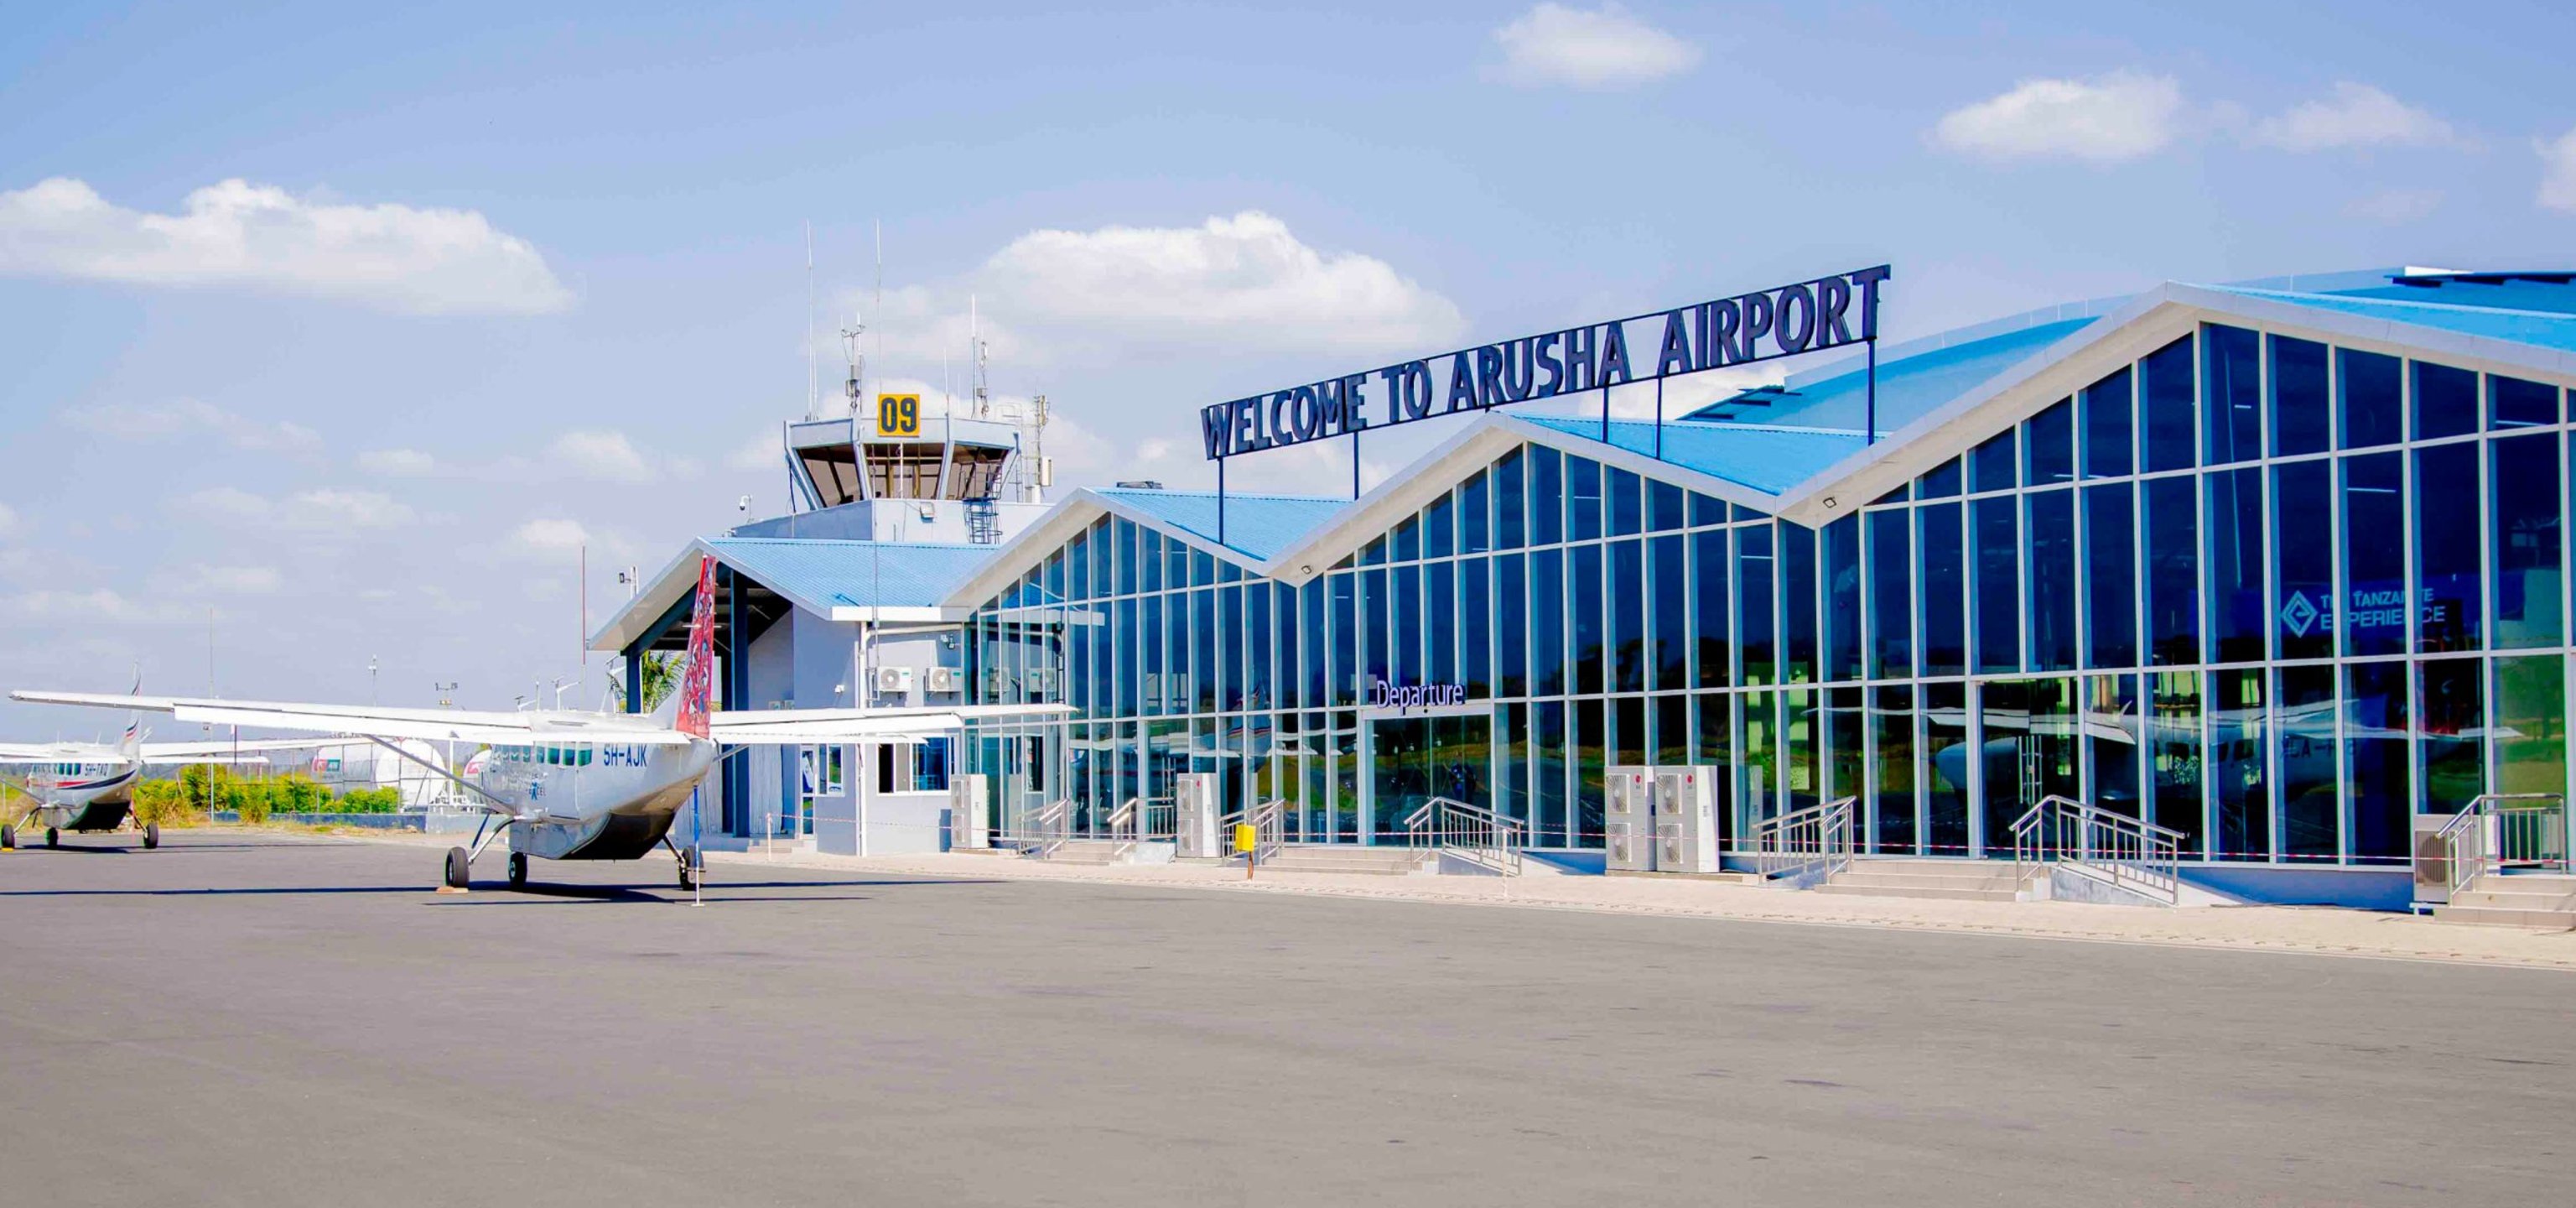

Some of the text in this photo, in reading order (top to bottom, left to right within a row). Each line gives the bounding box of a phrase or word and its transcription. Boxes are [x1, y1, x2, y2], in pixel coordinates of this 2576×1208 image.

[1201, 265, 1891, 459] WELCOME TO ARUSHA AIRPORT
[881, 398, 917, 433] 09
[2320, 606, 2446, 630] EPERIECE
[1377, 680, 1464, 716] Departure
[604, 743, 647, 768] 5H-AJK
